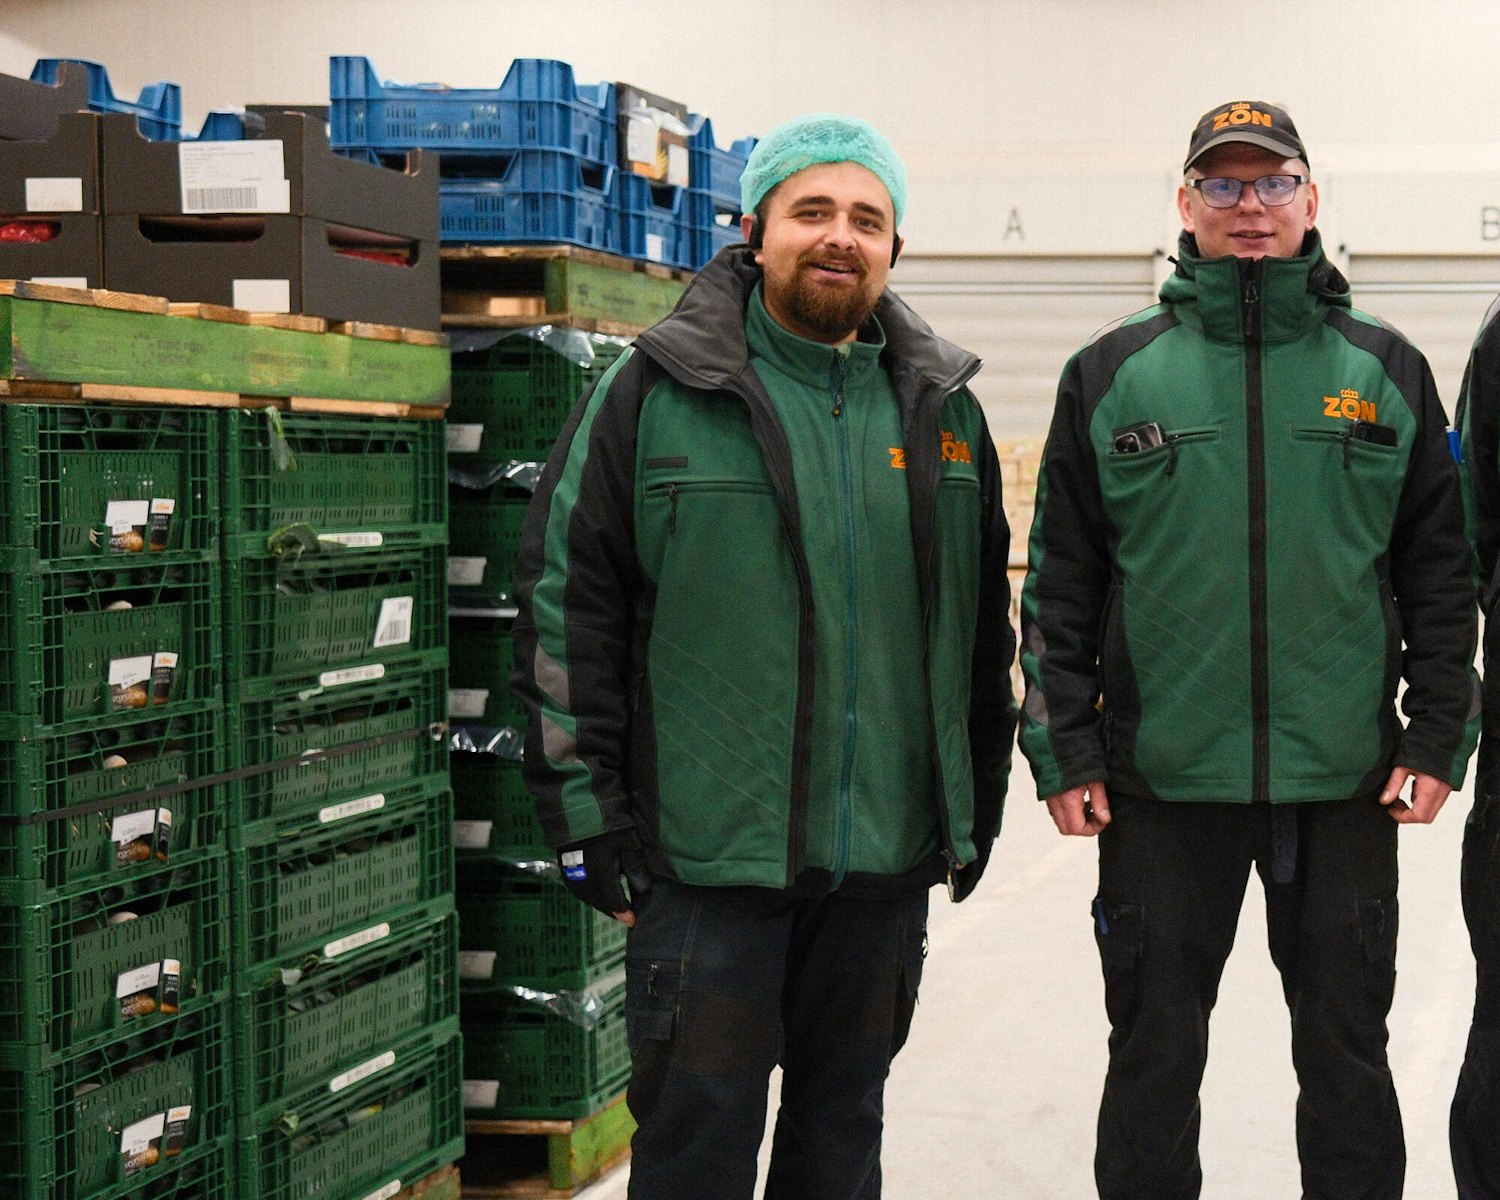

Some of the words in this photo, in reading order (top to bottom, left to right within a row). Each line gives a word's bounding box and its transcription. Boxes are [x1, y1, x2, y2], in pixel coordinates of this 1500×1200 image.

[1212, 109, 1272, 132] ZON
[1003, 206, 1026, 241] A
[1323, 395, 1376, 423] ZON
[941, 440, 972, 464] ON
